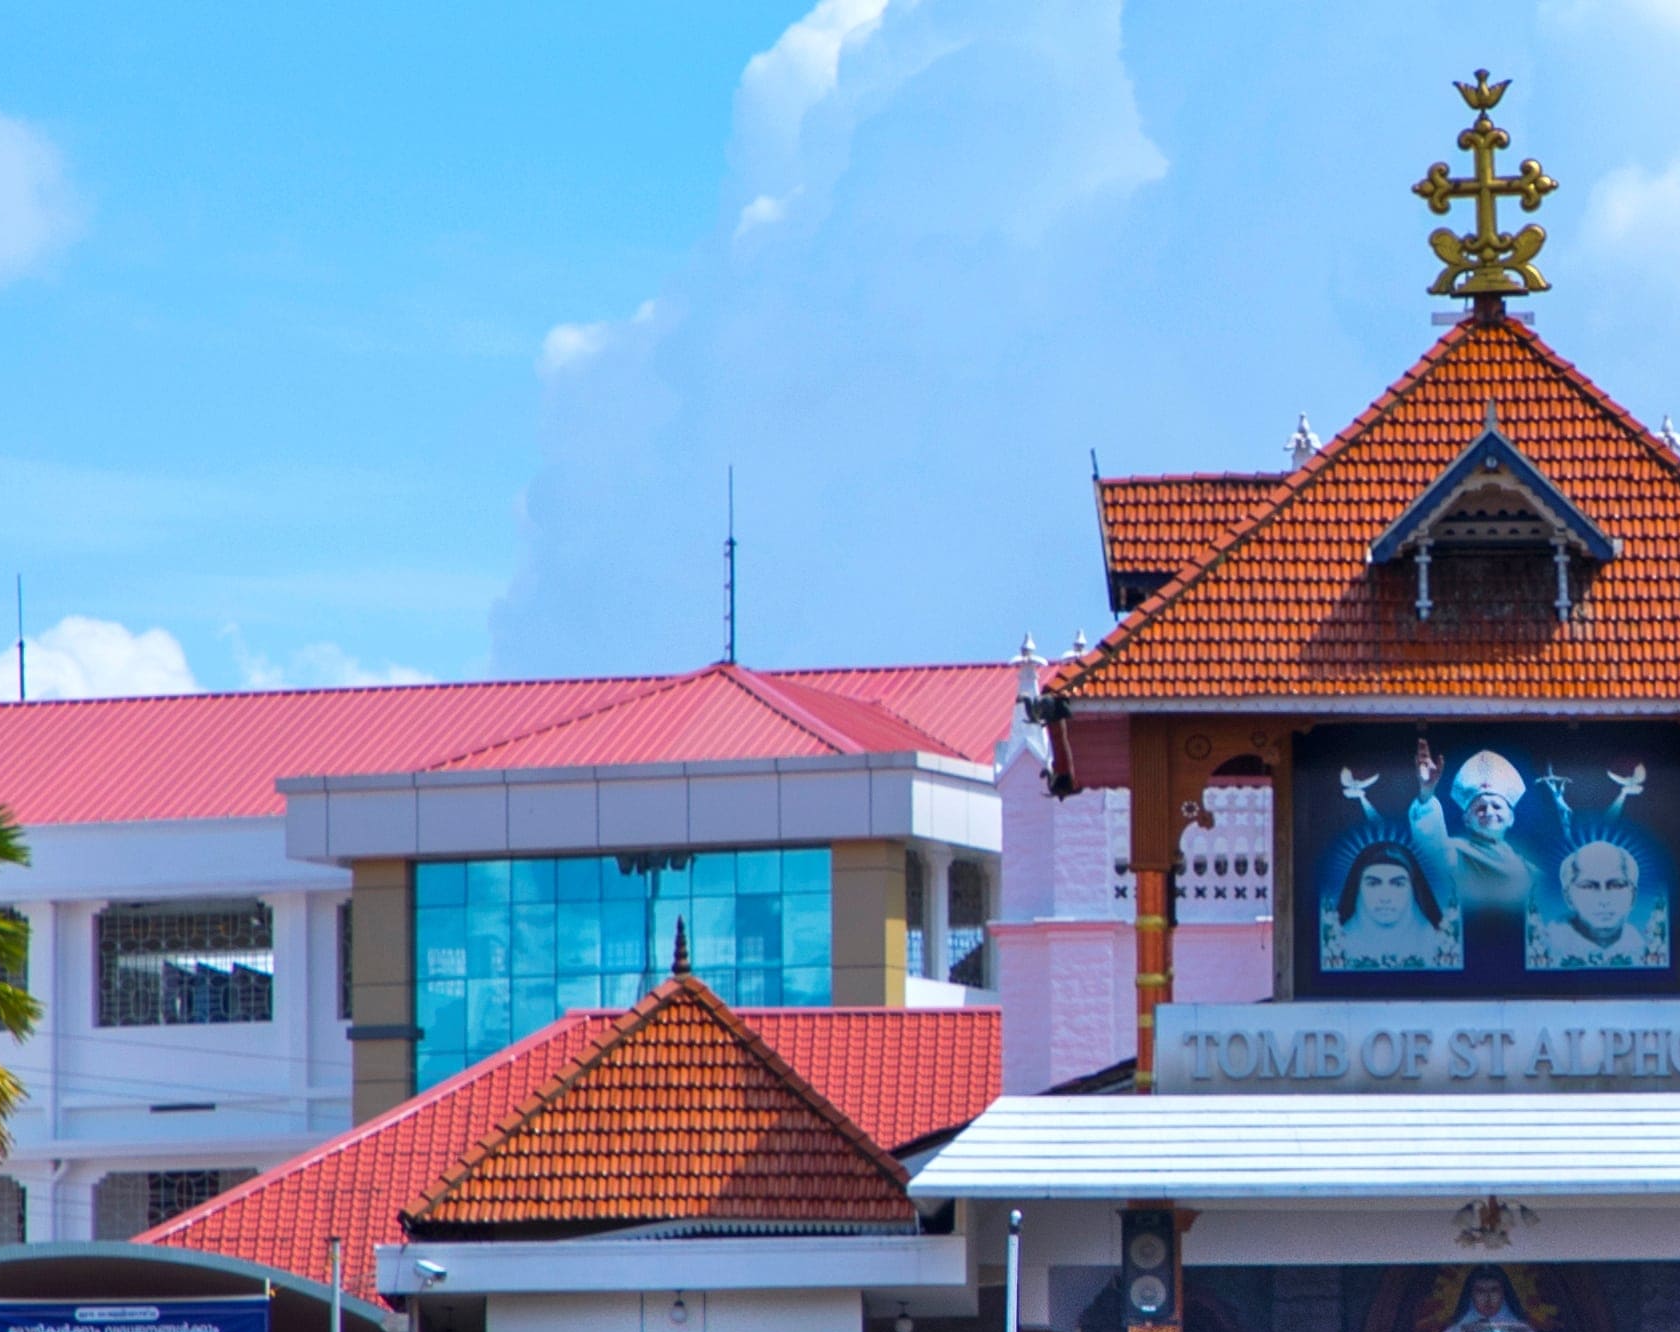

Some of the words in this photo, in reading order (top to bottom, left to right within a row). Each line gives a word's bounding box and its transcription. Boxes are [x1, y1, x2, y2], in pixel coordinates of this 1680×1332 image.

[1183, 1027, 1349, 1081] TOMB
[1361, 1028, 1431, 1080] OF
[1448, 1027, 1515, 1080] ST
